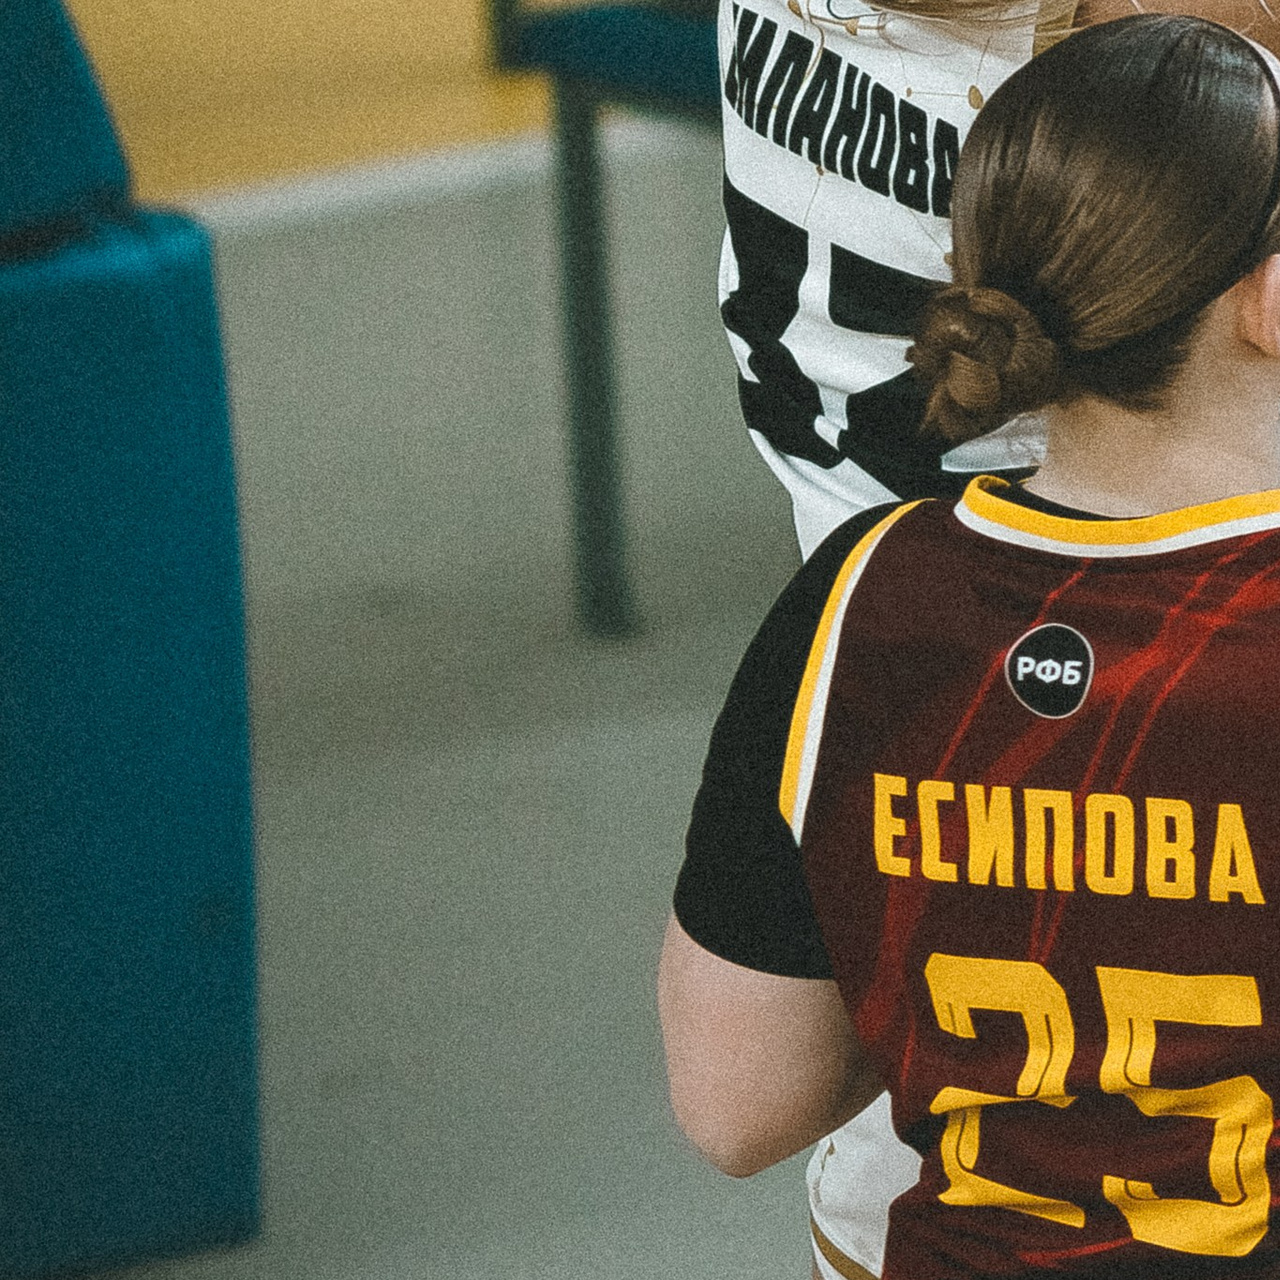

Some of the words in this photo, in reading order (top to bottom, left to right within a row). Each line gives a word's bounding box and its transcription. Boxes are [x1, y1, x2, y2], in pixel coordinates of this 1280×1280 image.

[1017, 656, 1083, 685] РФБ
[873, 772, 1266, 905] ЕСИПОВА
[924, 952, 1274, 1257] 25
